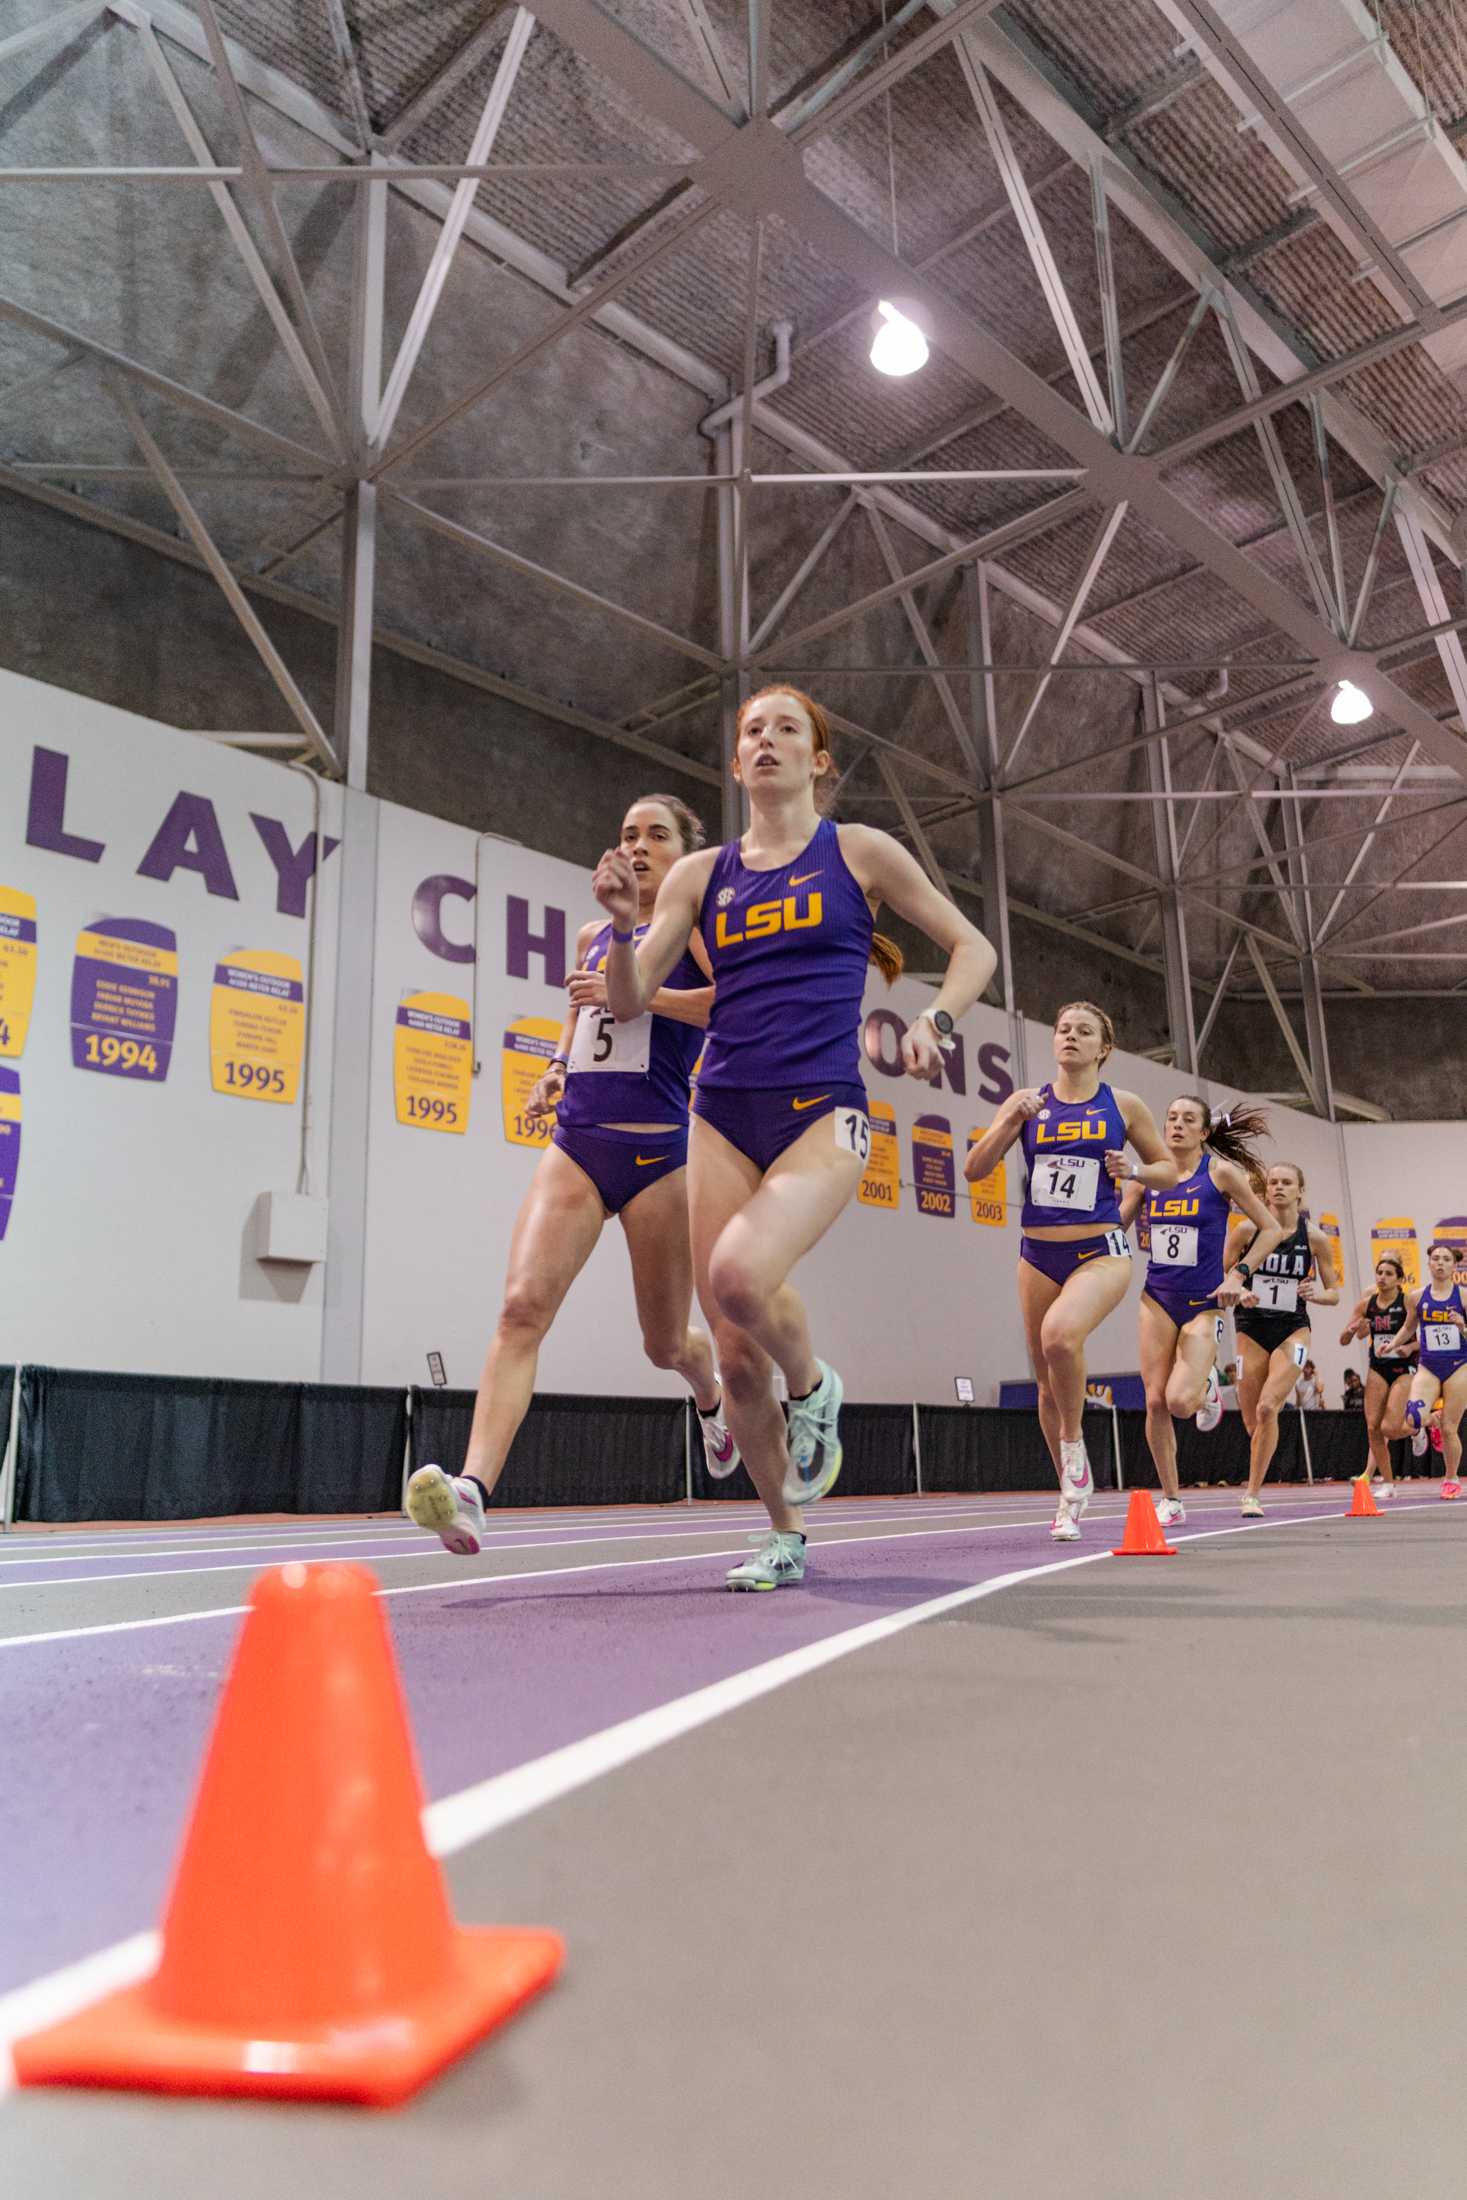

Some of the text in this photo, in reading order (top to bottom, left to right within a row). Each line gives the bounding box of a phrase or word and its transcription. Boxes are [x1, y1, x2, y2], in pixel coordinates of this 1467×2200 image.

[716, 892, 822, 949] LSU
[593, 1018, 615, 1062] 5
[85, 1034, 157, 1073] 1994
[225, 1061, 285, 1093] 1995
[406, 1095, 458, 1124] 1995
[1036, 1120, 1106, 1144] LSU
[1059, 1157, 1086, 1168] LSU
[862, 1180, 893, 1201] 2001
[1049, 1171, 1077, 1199] 14
[920, 1191, 951, 1212] 2002
[976, 1201, 1002, 1220] 2003
[1150, 1199, 1199, 1217] LSU
[1110, 1231, 1131, 1260] 14
[1167, 1234, 1180, 1259] 8
[1269, 1285, 1278, 1304] 1
[1435, 1333, 1450, 1346] 13
